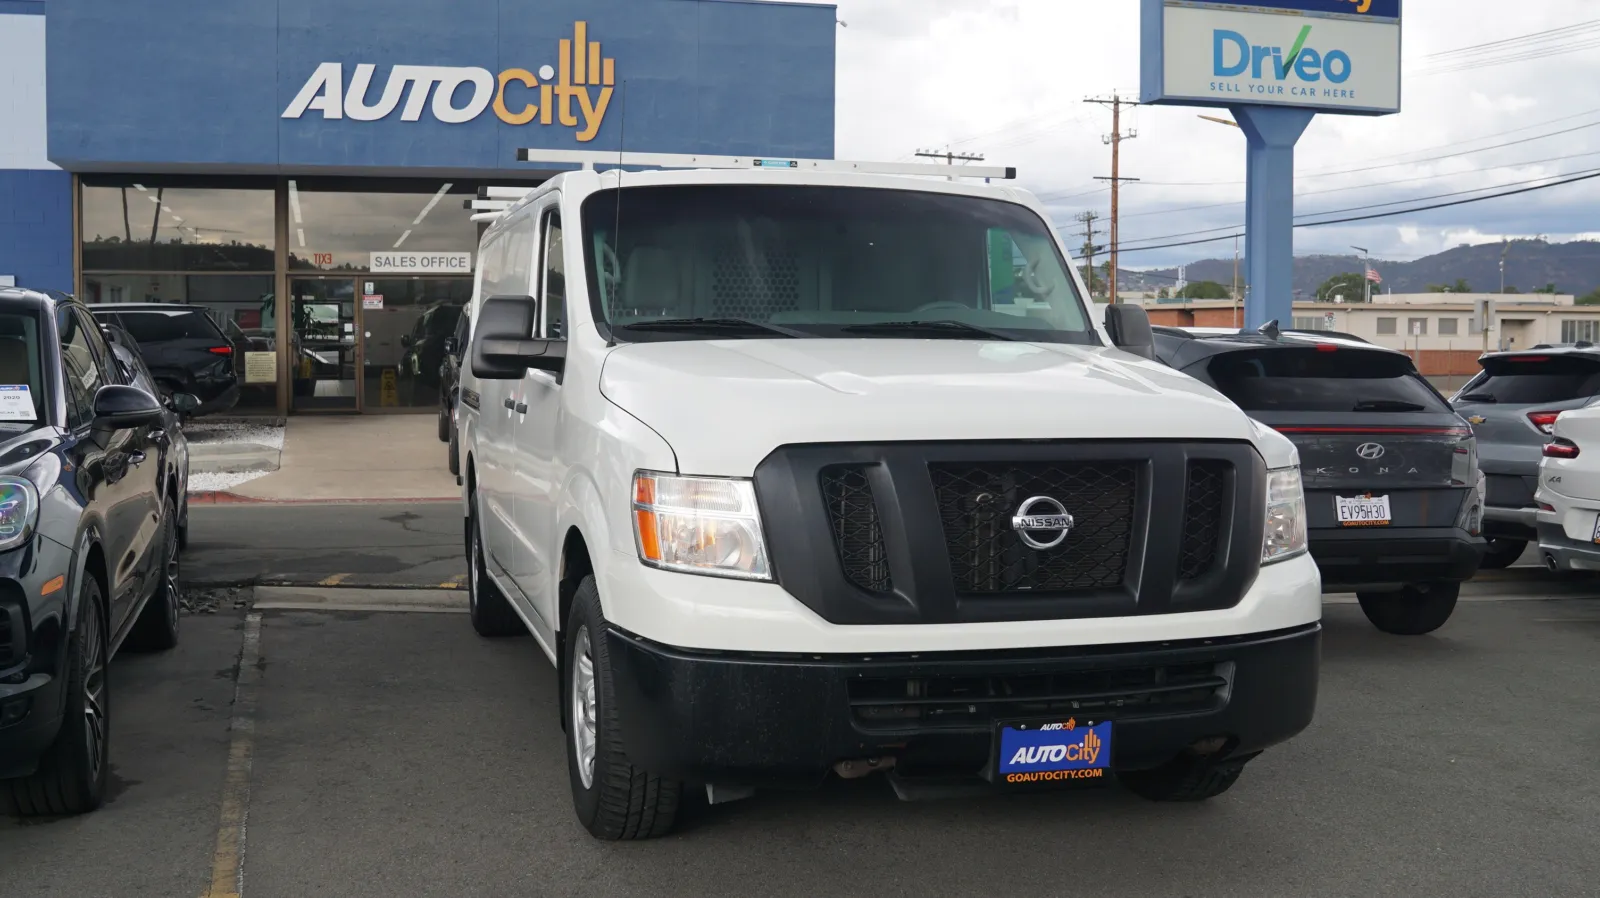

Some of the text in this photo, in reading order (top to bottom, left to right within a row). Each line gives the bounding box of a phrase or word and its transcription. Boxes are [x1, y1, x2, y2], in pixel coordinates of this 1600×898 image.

[1213, 25, 1352, 84] Driveo
[1210, 82, 1356, 99] SELL YOUR CAR HERE
[374, 256, 467, 268] SALES OFFICE
[1341, 505, 1385, 519] EV95H30
[1021, 518, 1070, 528] NISSAN
[1007, 769, 1102, 782] GOAUTOCITY.COM
